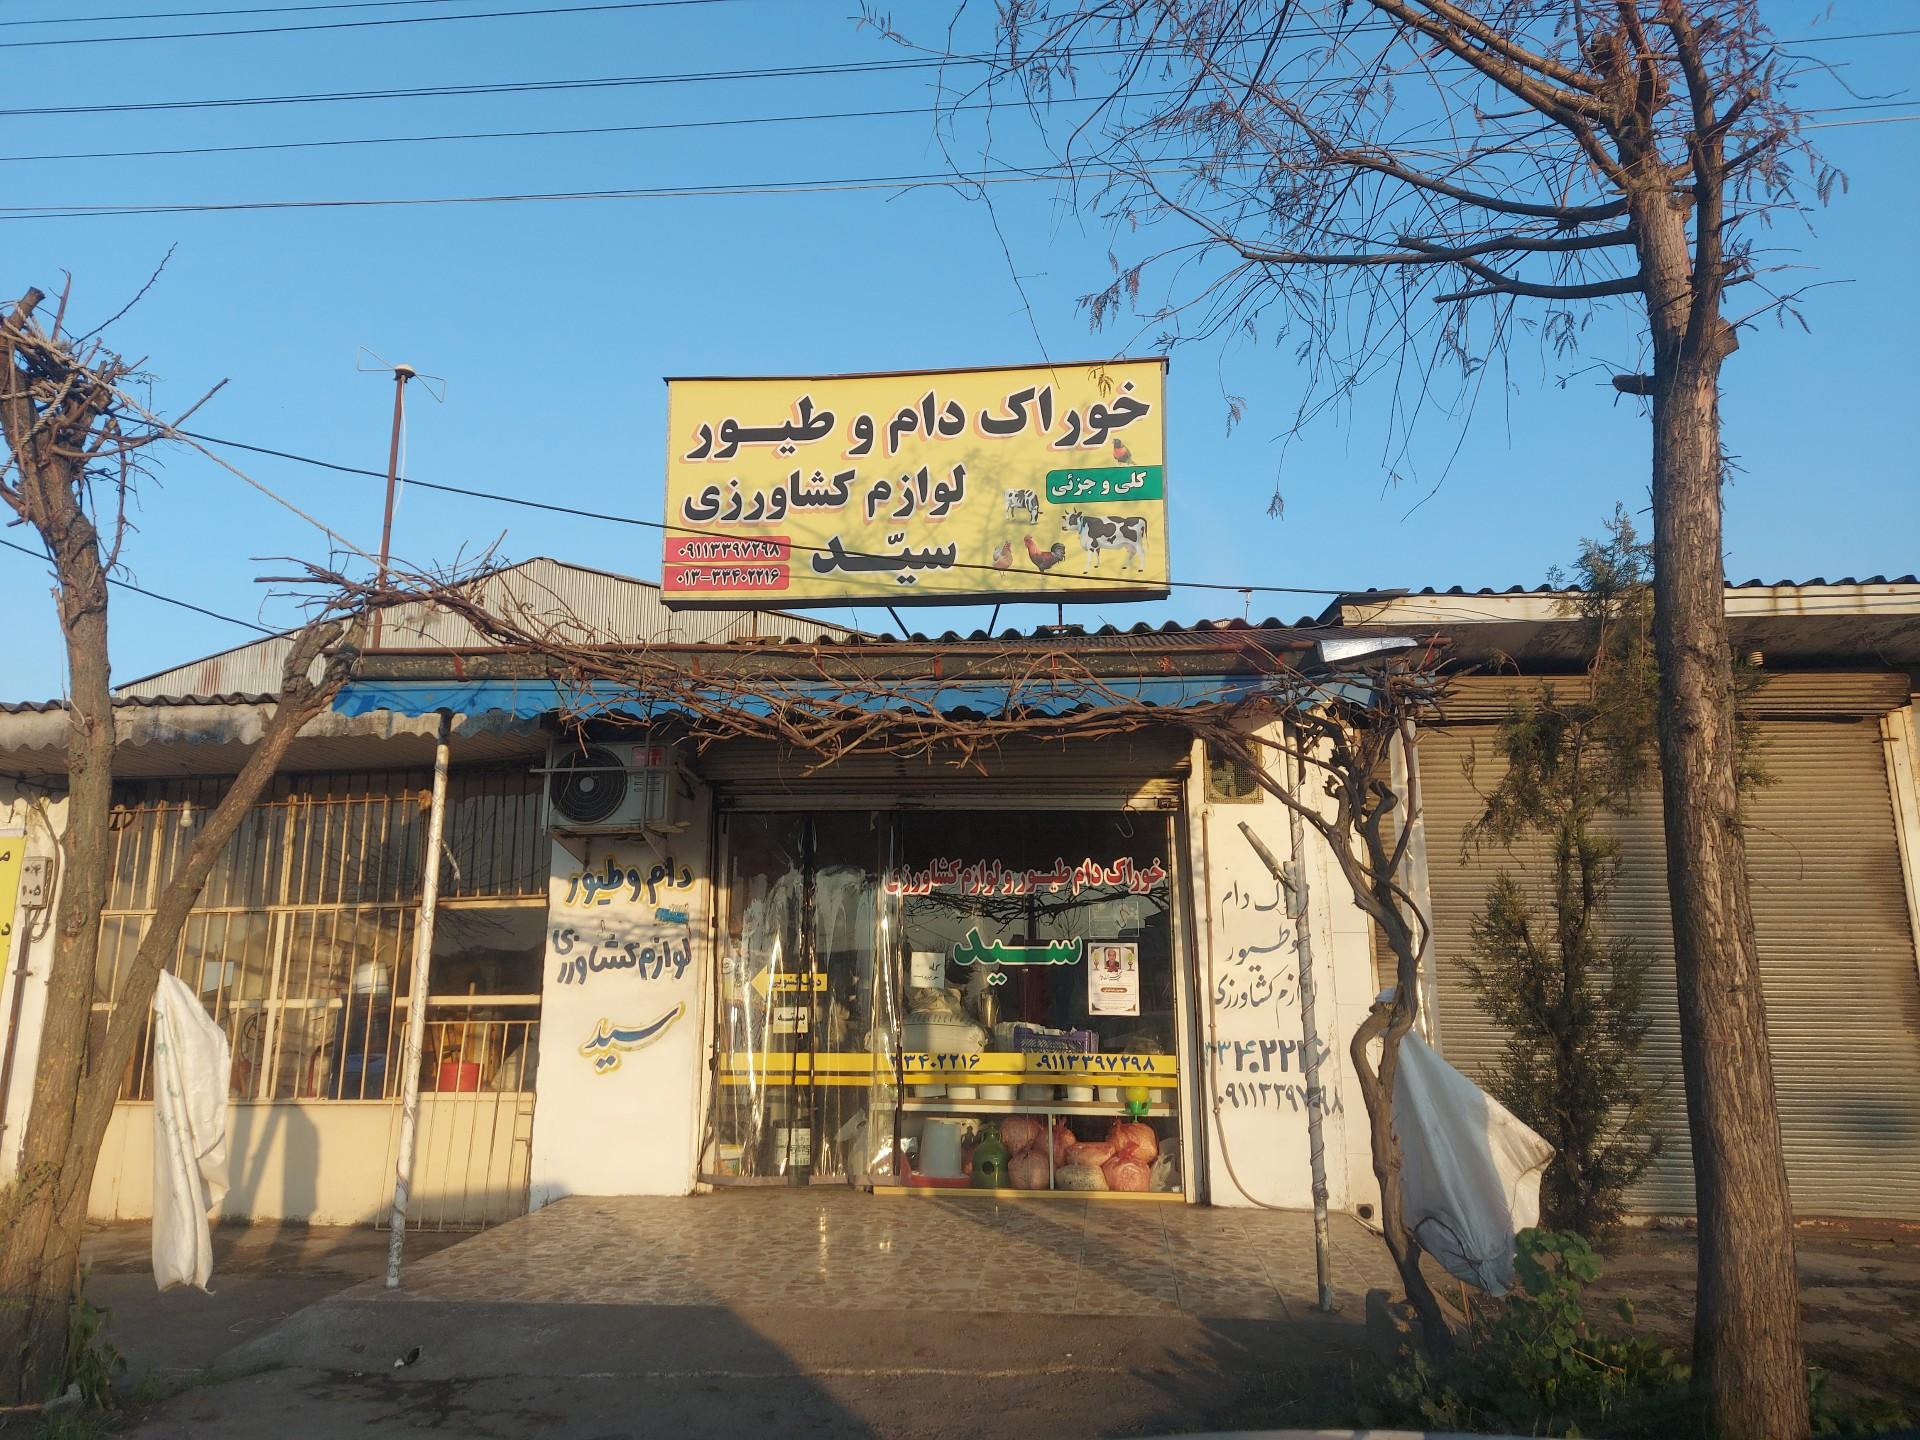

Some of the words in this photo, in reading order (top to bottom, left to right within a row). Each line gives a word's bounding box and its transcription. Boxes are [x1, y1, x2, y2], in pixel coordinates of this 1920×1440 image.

[685, 396, 835, 460] طیور
[848, 412, 876, 455] و
[889, 391, 967, 455] دام
[980, 379, 1152, 447] خوراک
[683, 469, 855, 522] کشاورزی
[865, 465, 967, 518] لوازم
[1051, 473, 1096, 496] جزئی
[1101, 479, 1110, 495] و
[1115, 471, 1147, 494] کلی
[678, 541, 781, 559] ۰۹۱۱۳۳۹۷۲۹۸
[649, 856, 692, 904] دام
[884, 857, 961, 895] کشاورزی
[961, 859, 1001, 895] لوازم
[1001, 869, 1014, 895] و
[1014, 857, 1072, 895] طیور
[1072, 858, 1103, 895] دام
[1104, 857, 1166, 894] خوراک
[1222, 880, 1250, 933] دام
[553, 927, 640, 984] کشاورزی
[639, 936, 692, 981] لوازم
[953, 927, 1082, 985] سید
[583, 1005, 686, 1070] سید
[1036, 1054, 1155, 1072] ۰۹۱۱۳۳۹۷۲۹۸
